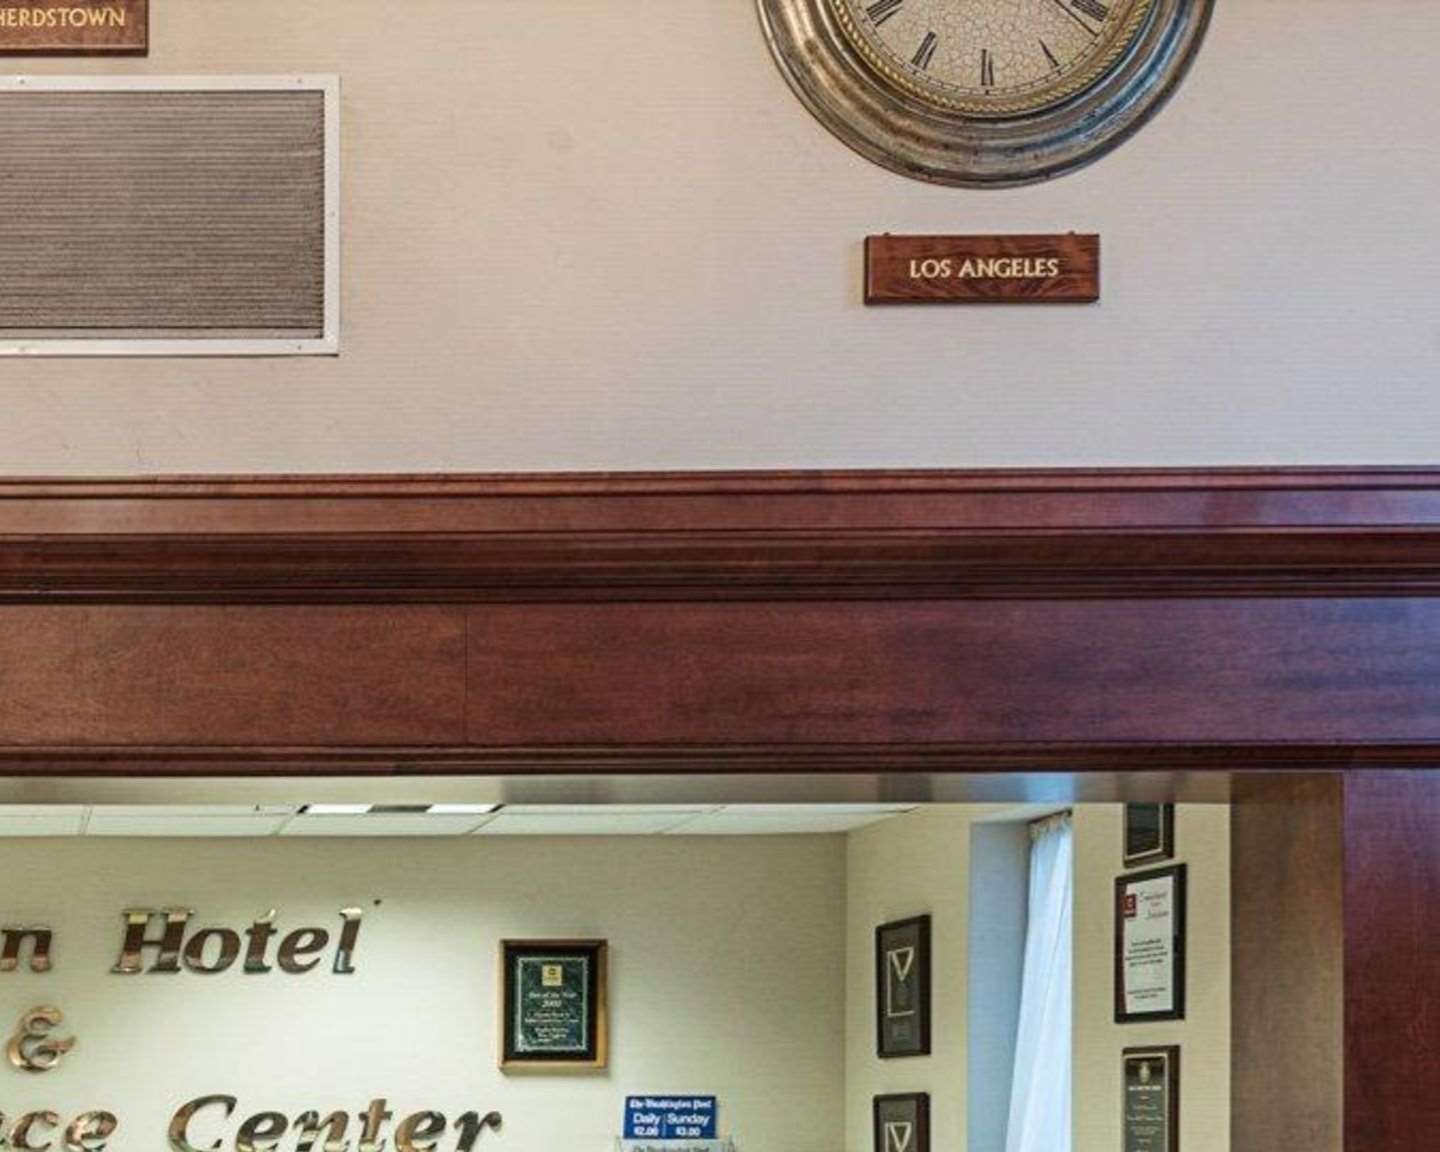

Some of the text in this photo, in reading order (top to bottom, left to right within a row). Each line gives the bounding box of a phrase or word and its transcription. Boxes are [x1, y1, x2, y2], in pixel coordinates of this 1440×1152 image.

[909, 257, 1060, 279] LOS ANGELES
[110, 906, 362, 976] Hotel
[5, 1004, 77, 1072] &
[633, 1111, 710, 1127] Daily Sunday
